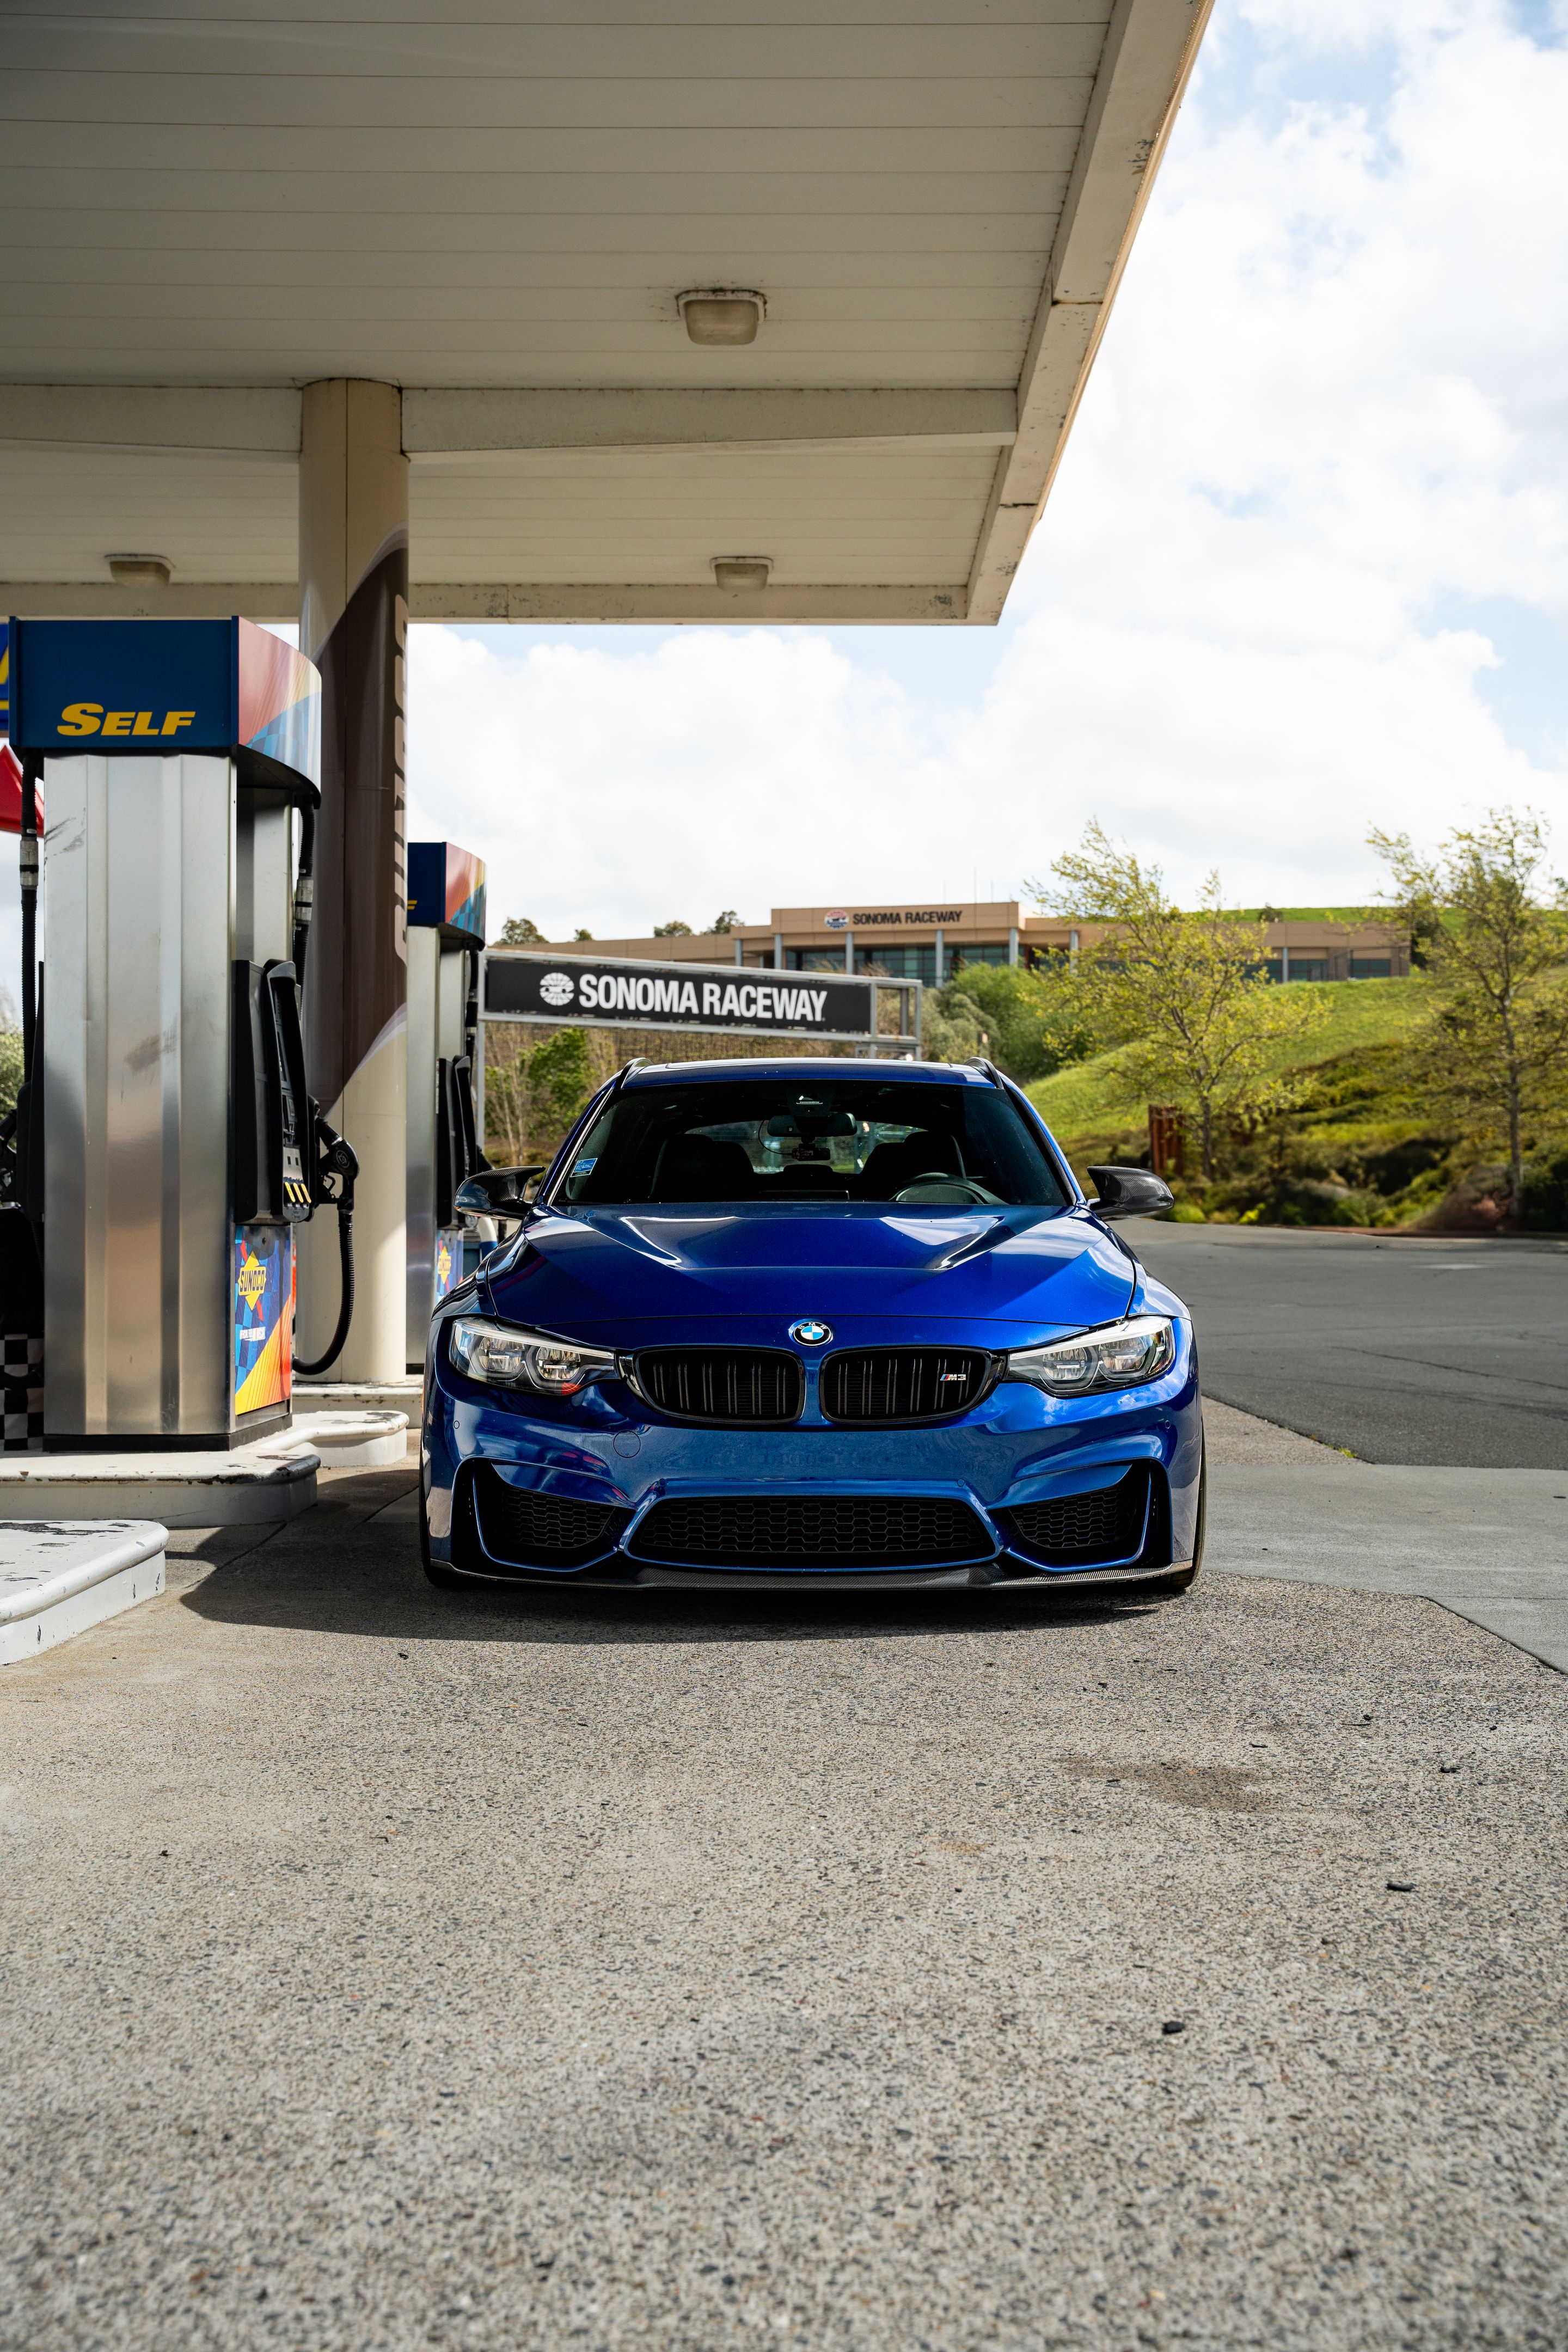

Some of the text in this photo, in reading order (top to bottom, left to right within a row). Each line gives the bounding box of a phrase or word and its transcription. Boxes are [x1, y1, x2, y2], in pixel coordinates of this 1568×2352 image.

[57, 702, 196, 736] SELF
[853, 913, 902, 925] SONOMA
[905, 911, 963, 924] RACEWAY
[579, 973, 828, 1022] SONOMA RACEWAY
[240, 1270, 265, 1293] SUNOCO
